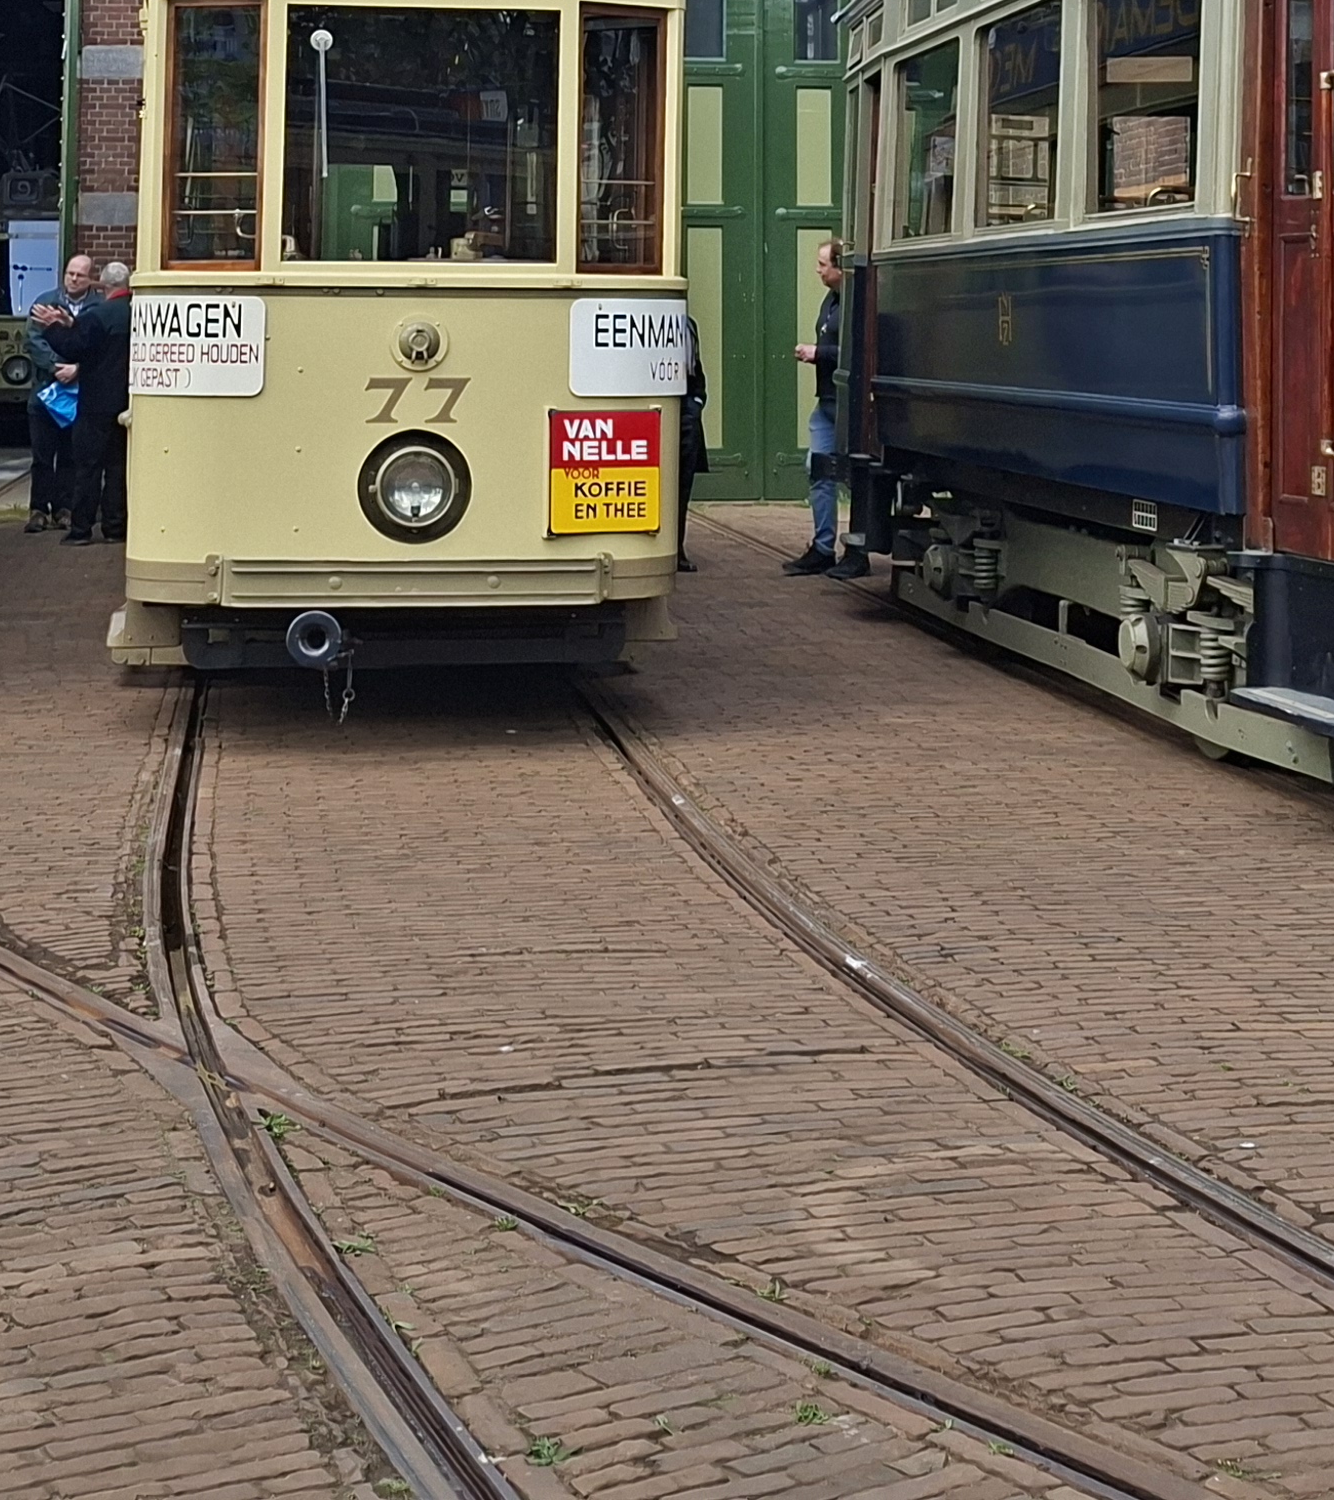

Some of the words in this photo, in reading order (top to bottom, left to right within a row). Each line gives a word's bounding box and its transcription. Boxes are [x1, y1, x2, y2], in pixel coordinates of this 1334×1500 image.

[149, 343, 195, 364] GEREED
[200, 343, 259, 364] HOUDEN
[141, 367, 180, 388] GEPAST
[364, 377, 472, 424] 77
[563, 418, 613, 439] VAN
[562, 440, 648, 461] NELLE
[563, 468, 599, 480] VOOR
[574, 480, 647, 498] KOFFIE
[574, 503, 598, 519] EN
[603, 502, 647, 519] THEE
